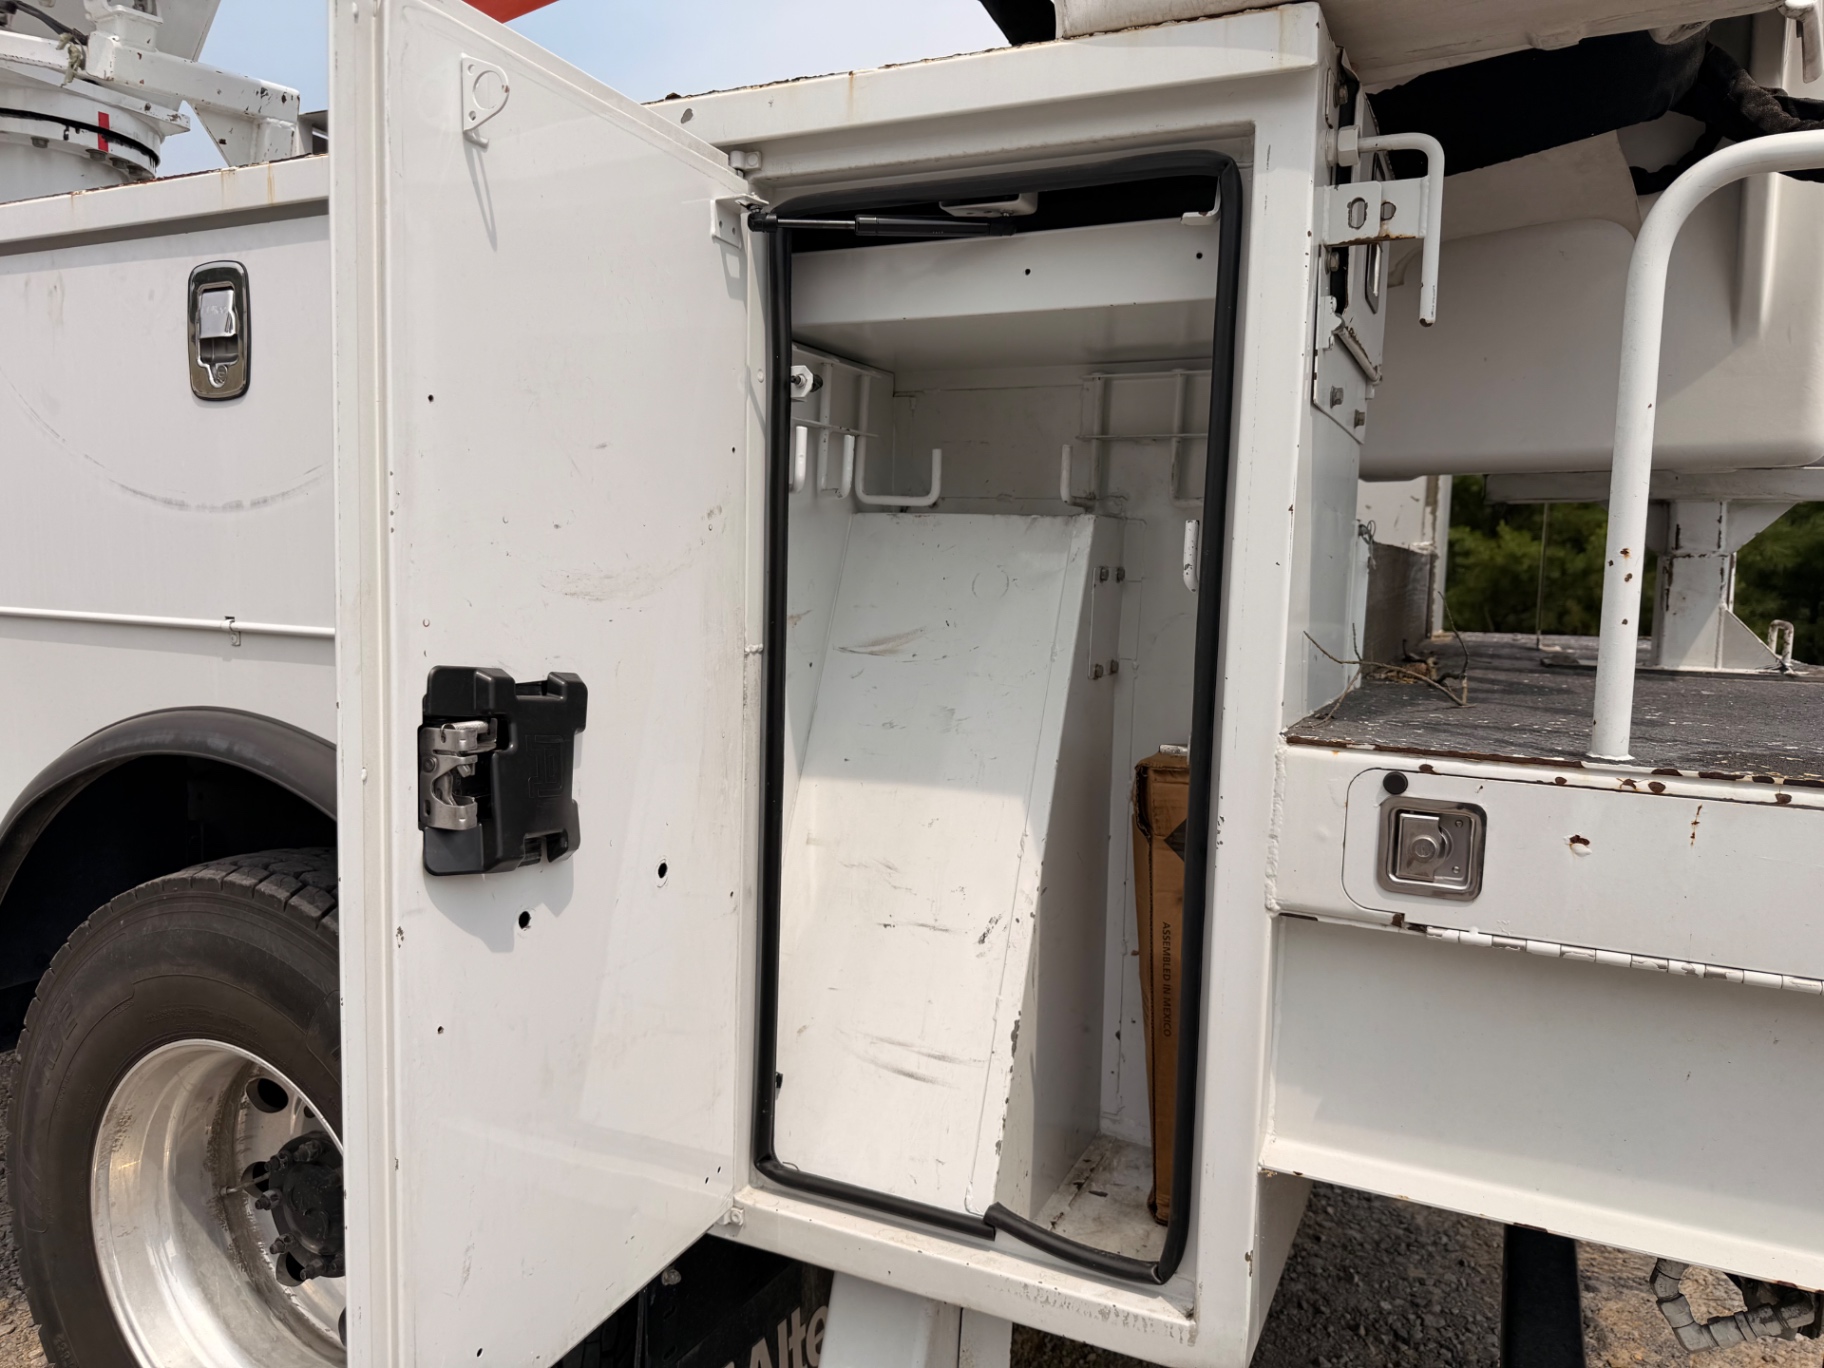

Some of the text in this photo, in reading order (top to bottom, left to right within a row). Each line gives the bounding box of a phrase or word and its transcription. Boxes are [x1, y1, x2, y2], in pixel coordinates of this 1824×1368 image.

[1163, 921, 1173, 1038] ASSEMBLED IN MEXICO
